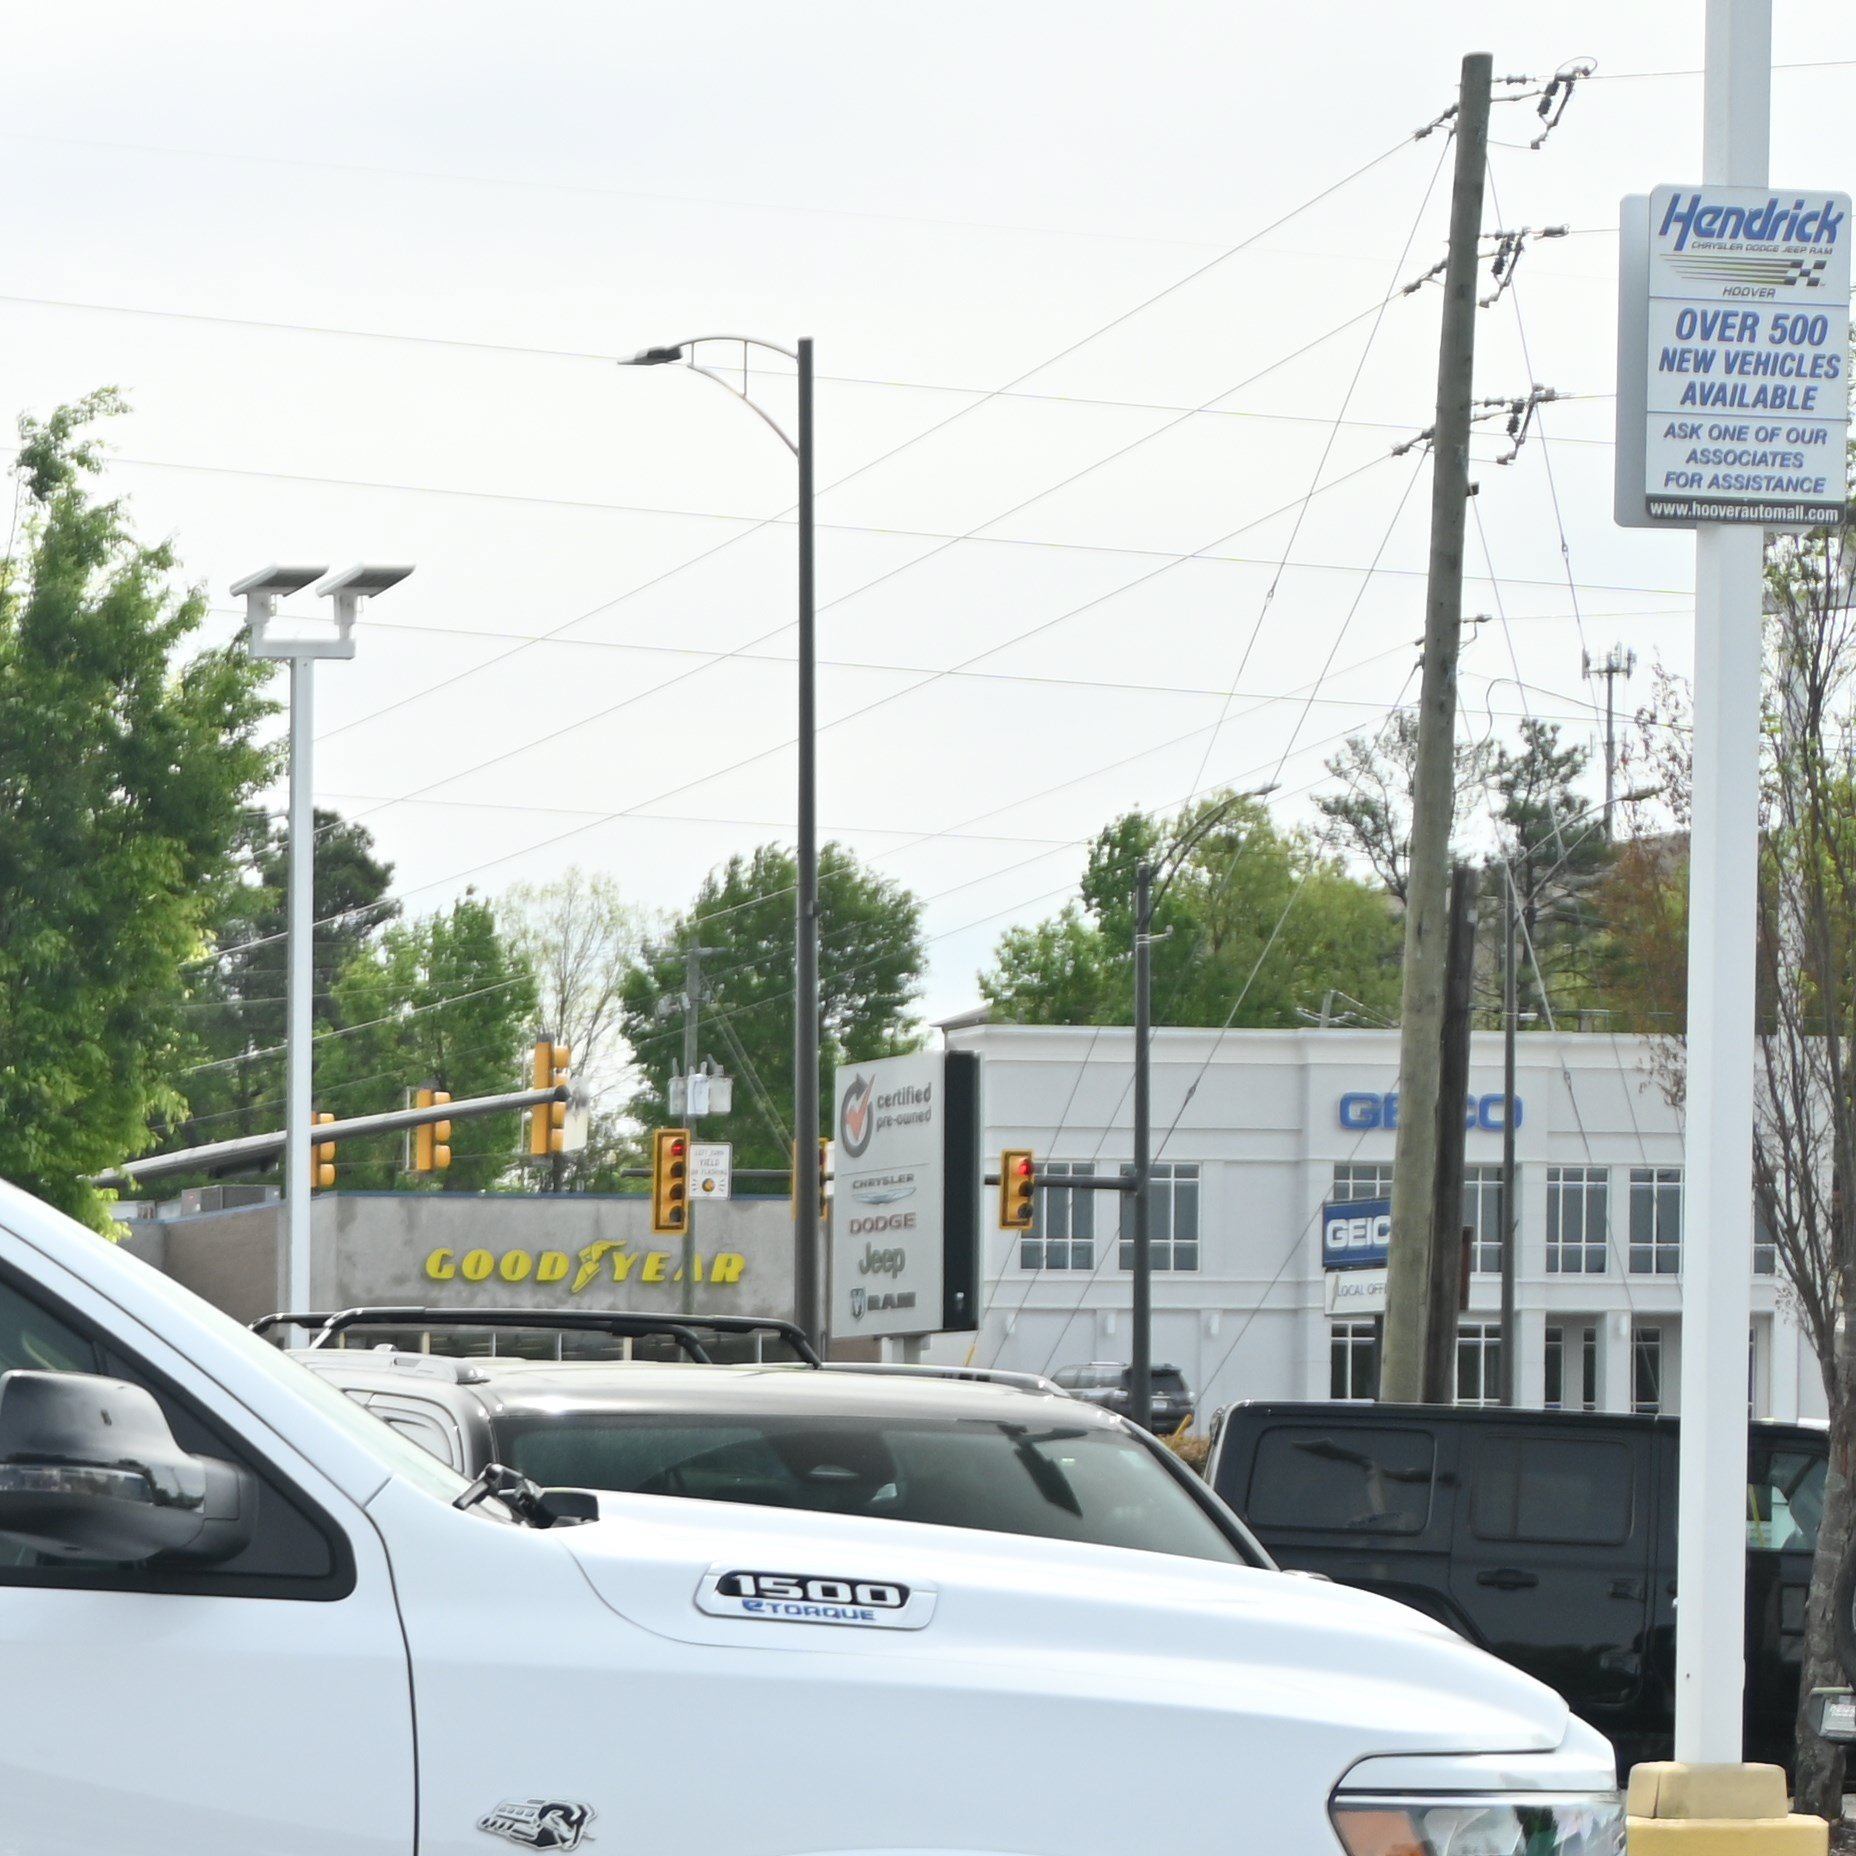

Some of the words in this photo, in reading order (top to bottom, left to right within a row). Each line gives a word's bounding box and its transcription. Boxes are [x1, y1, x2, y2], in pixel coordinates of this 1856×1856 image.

[1659, 192, 1844, 251] Hendrick
[1691, 240, 1743, 251] CHRYSLER
[1746, 243, 1779, 253] DODGE
[1782, 245, 1807, 254] JEEP
[1809, 246, 1833, 255] RAM
[1722, 285, 1776, 298] HOOVER
[1675, 307, 1759, 343] OVER
[1768, 312, 1828, 346] 500
[1659, 347, 1716, 374] NEW
[1724, 350, 1840, 379] VEHICLES
[1680, 381, 1818, 411] AVAILABLE
[1663, 422, 1702, 440] ASK
[1708, 423, 1749, 442] ONE
[1755, 425, 1781, 443] OF
[1786, 426, 1828, 445] OUR
[1685, 448, 1804, 469] ASSOCIATES
[1663, 471, 1703, 488] FOR
[1707, 473, 1826, 494] ASSISTANCE
[1650, 499, 1839, 522] www.hooverautomall.com
[876, 1081, 932, 1108] certified
[876, 1106, 932, 1132] pre-owned
[1340, 1091, 1523, 1131] GEO
[852, 1173, 914, 1189] CHRYSLER
[849, 1212, 916, 1234] DODGE
[1326, 1214, 1391, 1248] GEIC
[859, 1242, 906, 1279] Jeep
[731, 1574, 901, 1607] 1500
[741, 1598, 876, 1621] eTORQUE
